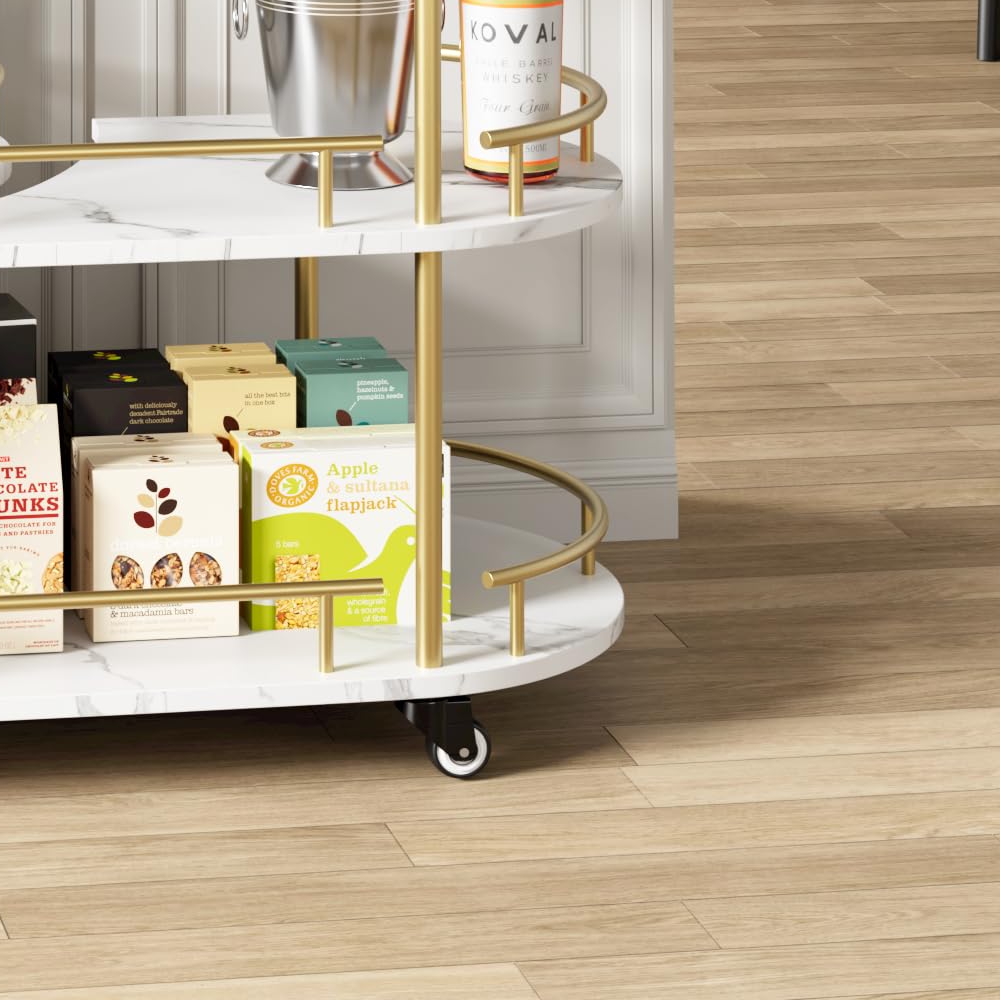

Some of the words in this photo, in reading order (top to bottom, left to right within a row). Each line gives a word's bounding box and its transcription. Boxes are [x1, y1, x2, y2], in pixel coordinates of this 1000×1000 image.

[470, 19, 557, 44] KOVAL
[482, 71, 549, 84] WHISKEY
[144, 401, 178, 410] deliciously
[129, 417, 143, 425] dark
[144, 416, 174, 424] chocolate
[327, 461, 378, 479] Apple
[269, 466, 292, 494] DOVES
[292, 464, 316, 484] FARM
[327, 481, 341, 493] &
[345, 479, 410, 493] sultana
[274, 485, 316, 507] ORGANIC
[326, 496, 398, 514] flapjack
[110, 608, 119, 619] &
[120, 607, 173, 618] macadamia
[174, 606, 194, 616] bars
